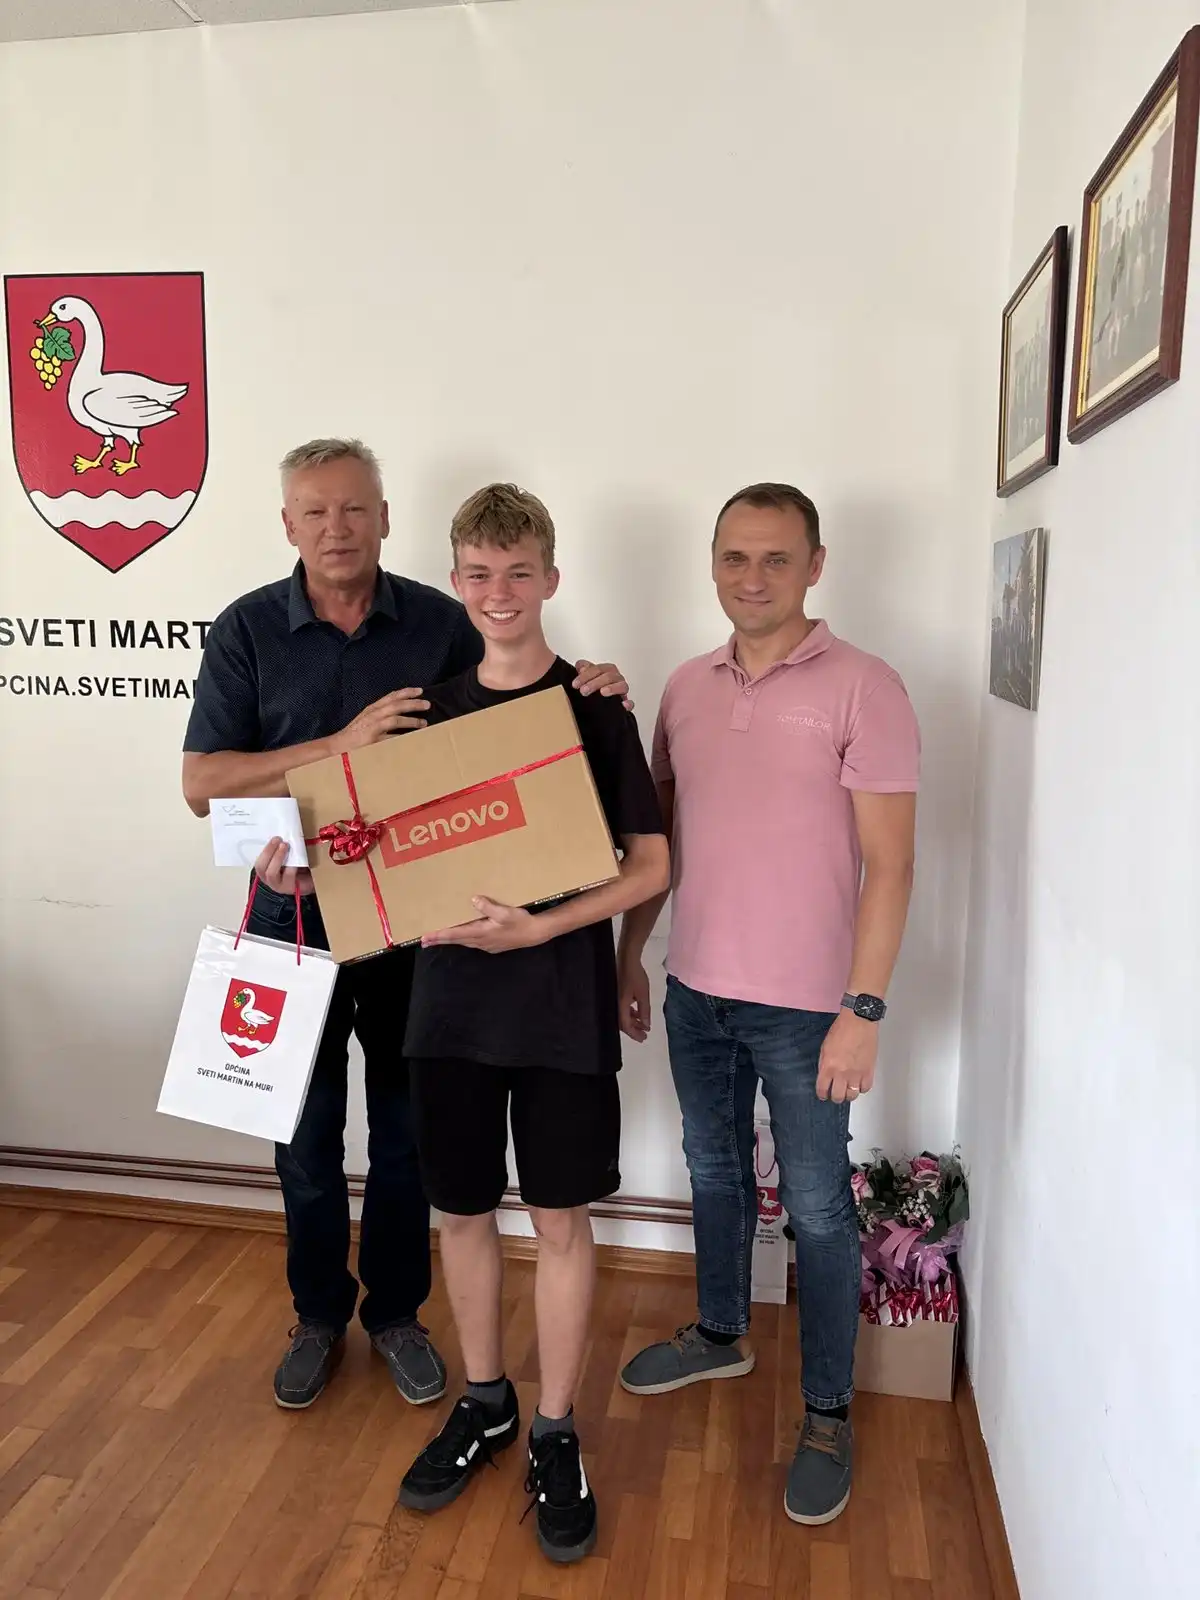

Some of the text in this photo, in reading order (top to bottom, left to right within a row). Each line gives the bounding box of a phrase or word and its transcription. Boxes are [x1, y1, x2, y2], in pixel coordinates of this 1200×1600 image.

[0, 617, 97, 648] SVETI
[389, 800, 509, 853] Lenovo
[197, 1067, 273, 1092] SVETI MARTIN NA MURI
[225, 1063, 250, 1075] OPĆINA
